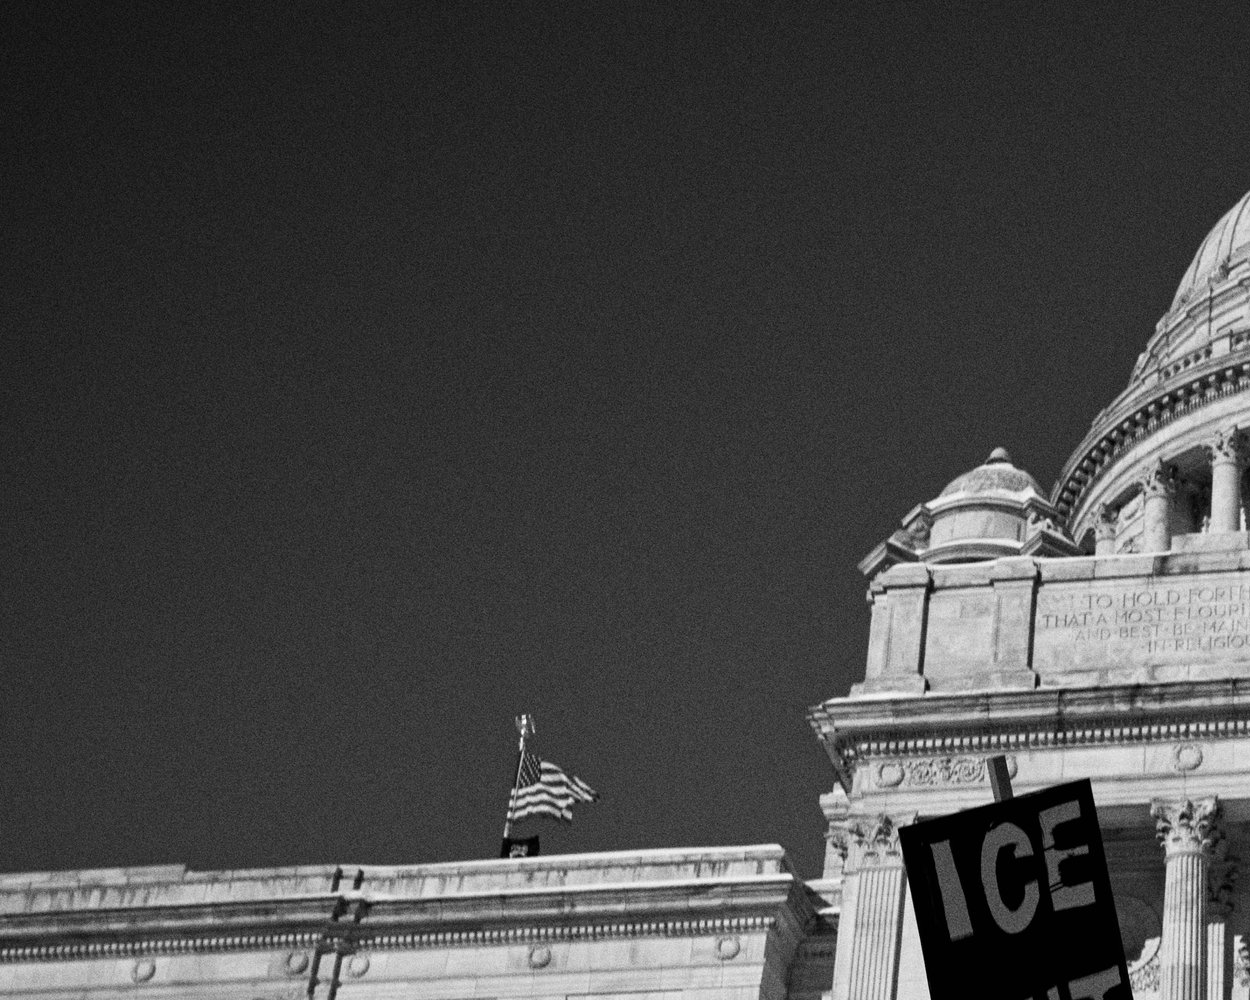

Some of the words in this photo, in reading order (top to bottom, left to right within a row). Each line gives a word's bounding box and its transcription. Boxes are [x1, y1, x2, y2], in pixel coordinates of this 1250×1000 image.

[1084, 593, 1112, 610] TO
[1122, 589, 1180, 608] HOLD
[1043, 612, 1091, 629] THAT
[1096, 611, 1107, 626] A
[1115, 607, 1163, 624] MOST
[1075, 626, 1110, 642] AND
[1119, 623, 1160, 639] BEST
[1173, 621, 1192, 636] BE
[1148, 639, 1165, 653] IN
[930, 800, 1096, 941] ICE
